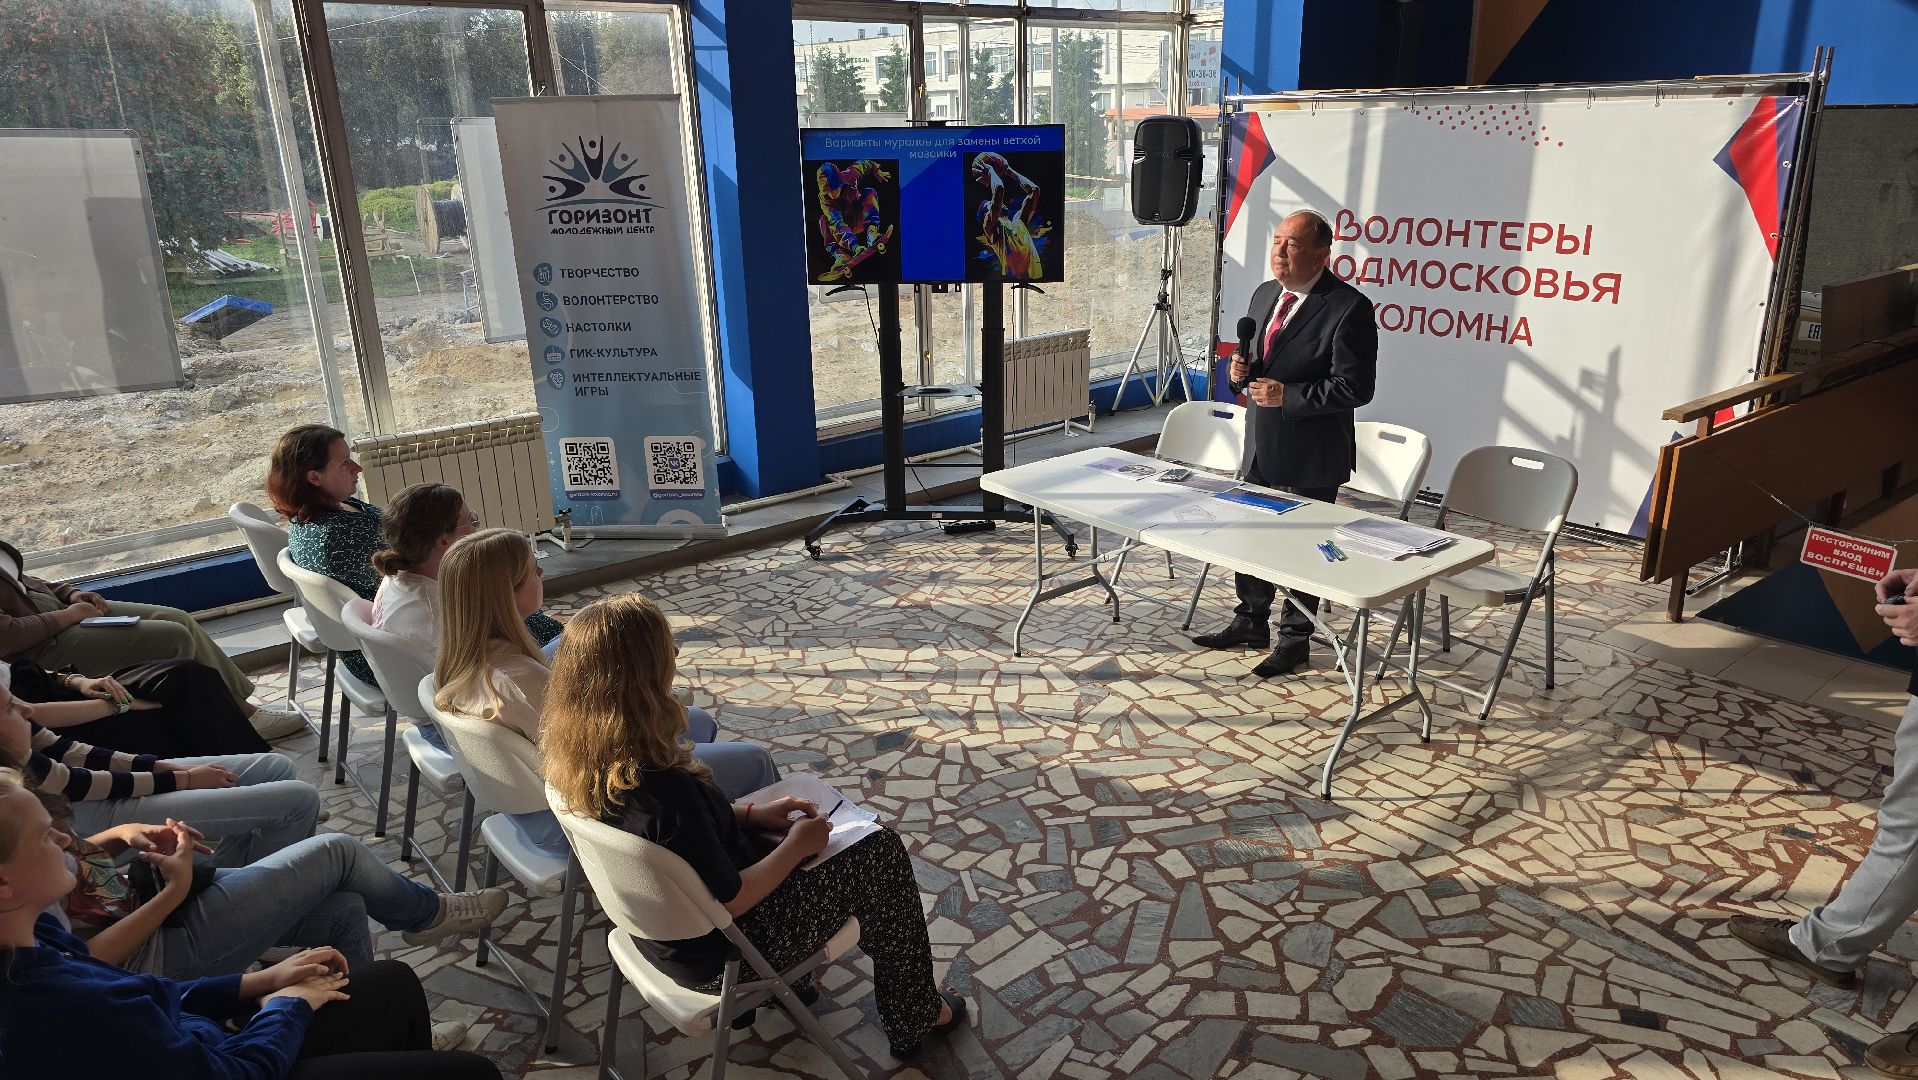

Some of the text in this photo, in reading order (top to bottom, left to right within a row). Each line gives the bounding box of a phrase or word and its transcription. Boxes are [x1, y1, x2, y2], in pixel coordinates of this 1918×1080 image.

[825, 134, 1041, 150] Варианты муралов для замены ветхой
[547, 207, 653, 225] ГОРИЗОНТ
[626, 225, 655, 234] ЦЕНТР
[1333, 208, 1593, 256] ВОЛОНТЕРЫ
[559, 267, 640, 279] ТВОРЧЕСТВО
[1325, 254, 1623, 305] ОДМОСКОВЬЯ
[562, 294, 660, 306] ВОЛОНТЕРСТВО
[565, 321, 632, 333] НАСТОЛКИ
[1808, 323, 1821, 339] EA
[568, 347, 659, 360] ГИК-КУЛЬТУРА
[572, 370, 702, 383] ИНТЕЛЛЕКТУАЛЬНЫЕ
[574, 386, 610, 397] ИГРЫ
[1811, 533, 1891, 559] ПОСТОРОННИМ
[1832, 548, 1863, 563] ВХОД
[1807, 551, 1884, 578] ВОСПРЕЩЁН
